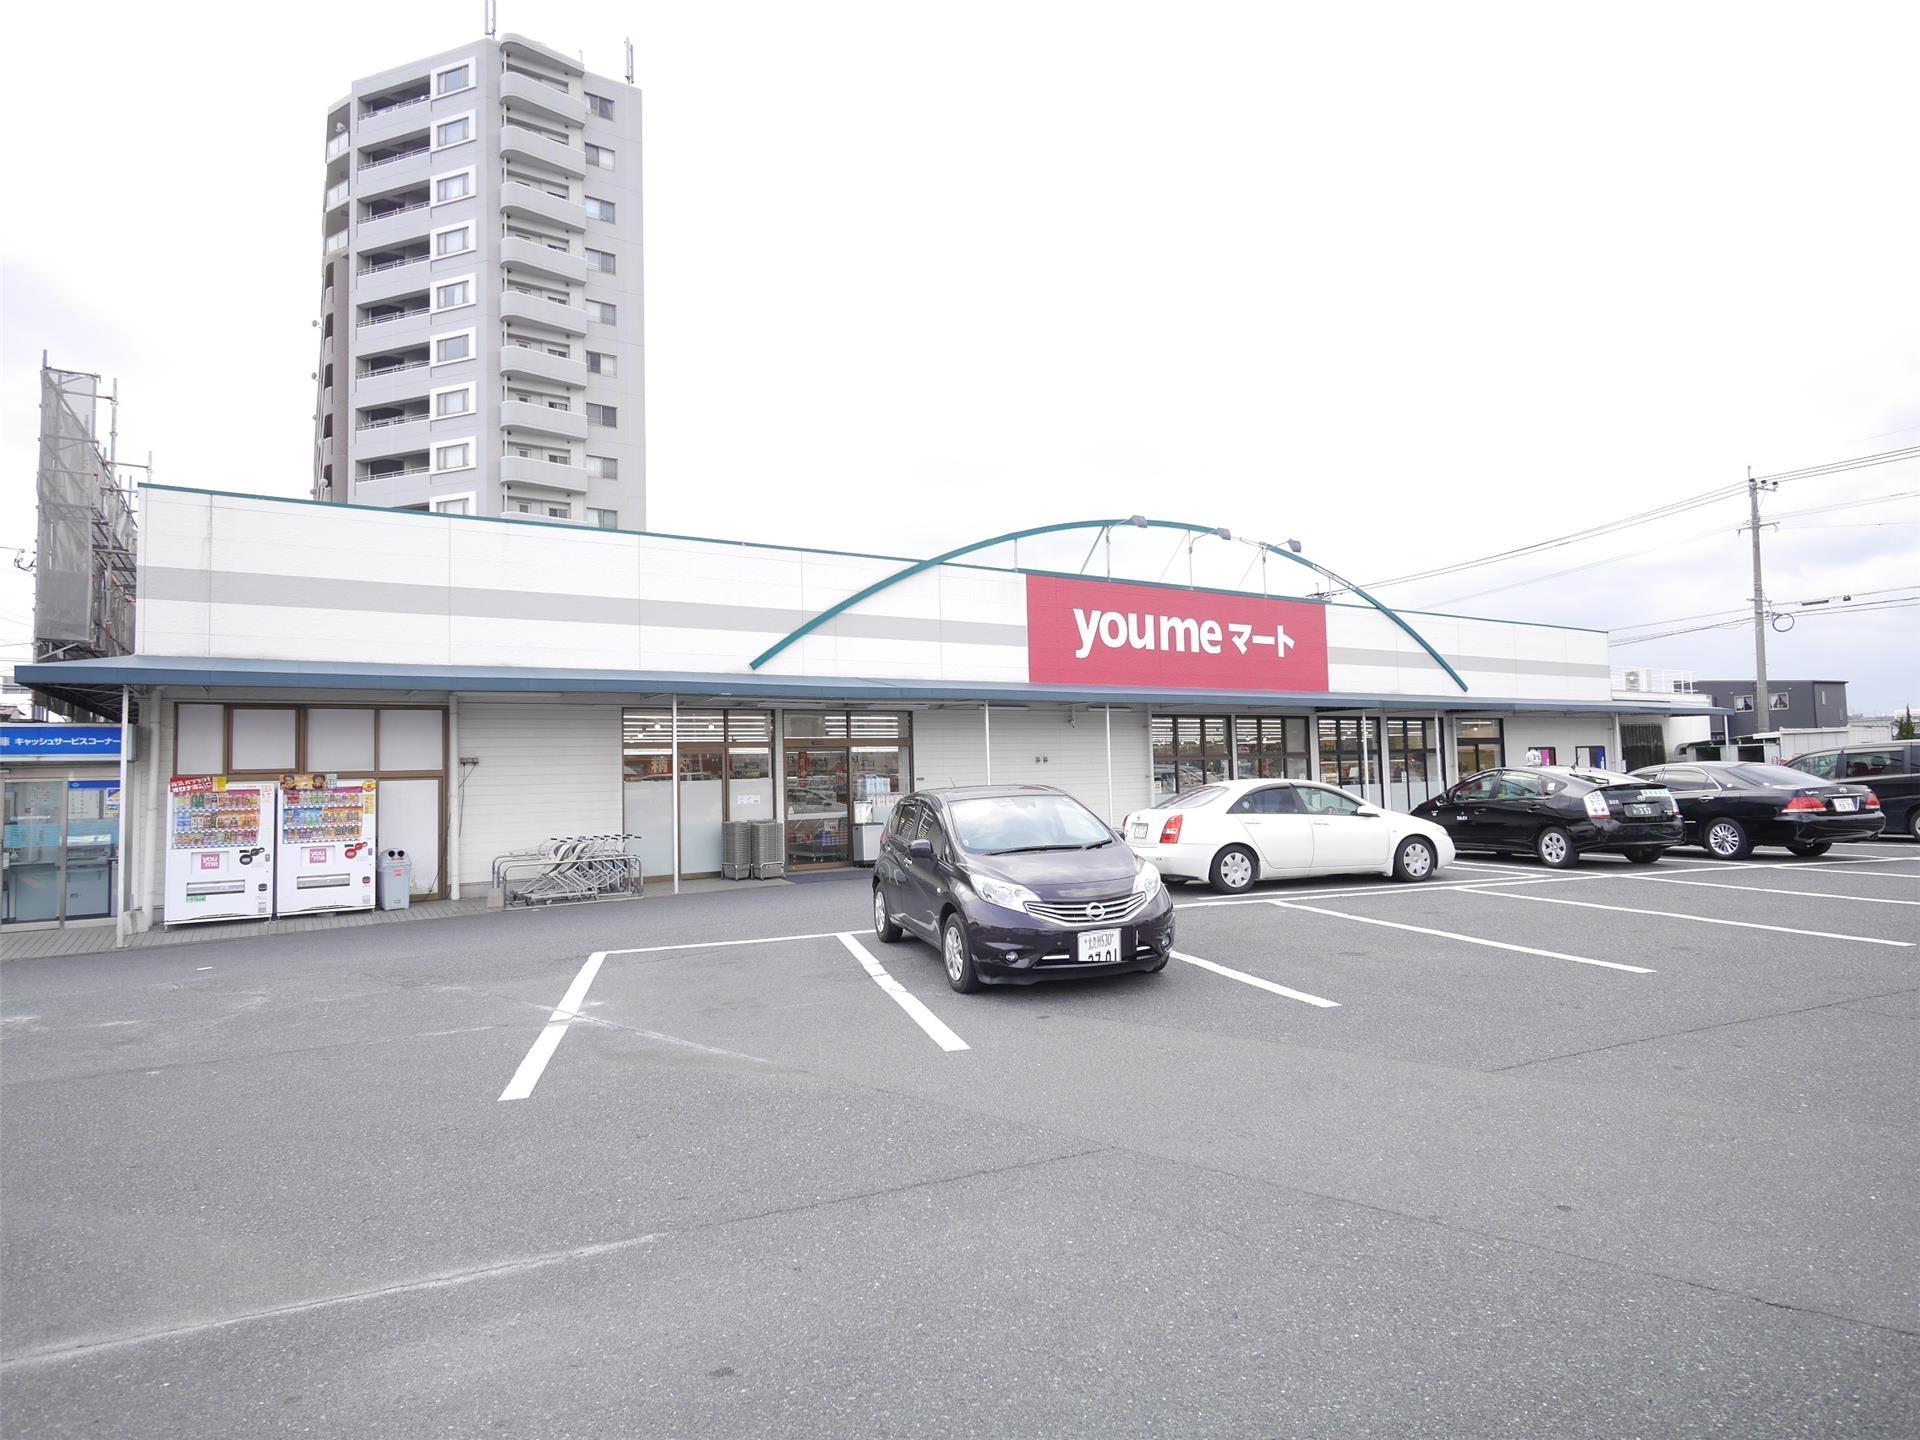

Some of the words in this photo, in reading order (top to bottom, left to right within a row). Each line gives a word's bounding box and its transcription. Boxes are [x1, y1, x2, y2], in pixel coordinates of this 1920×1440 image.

[1228, 623, 1295, 658] マート
[15, 737, 121, 746] キャッシュサービスコーナー
[202, 856, 218, 864] you
